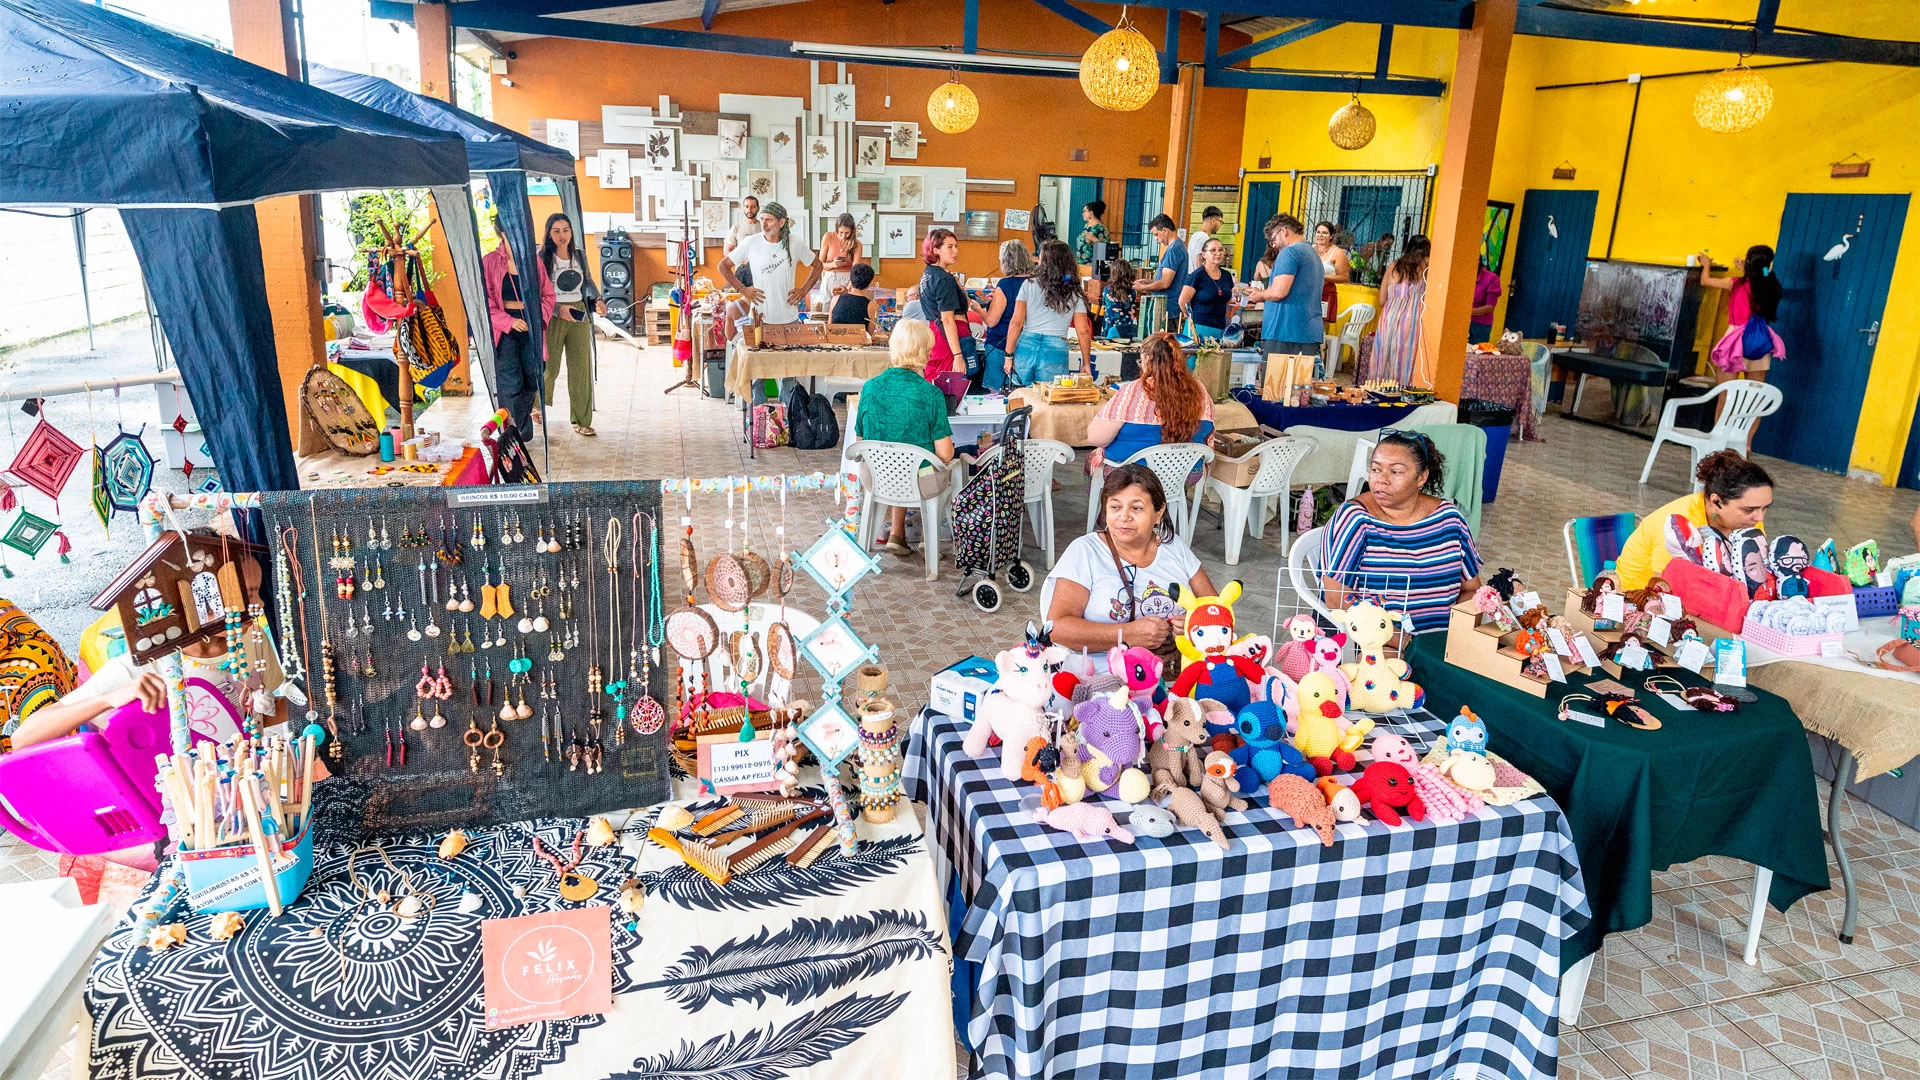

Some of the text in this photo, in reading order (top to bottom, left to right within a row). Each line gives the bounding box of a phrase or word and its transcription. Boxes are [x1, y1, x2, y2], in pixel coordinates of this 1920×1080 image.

[734, 749, 749, 758] PIX
[713, 764, 729, 773] (13)
[714, 775, 739, 784] CÁSSIA
[191, 876, 240, 900] EQUILIBRISTAS
[192, 899, 215, 911] FAVOR
[214, 885, 244, 901] BRINCAR
[244, 878, 258, 887] COM
[522, 960, 576, 976] FELIX
